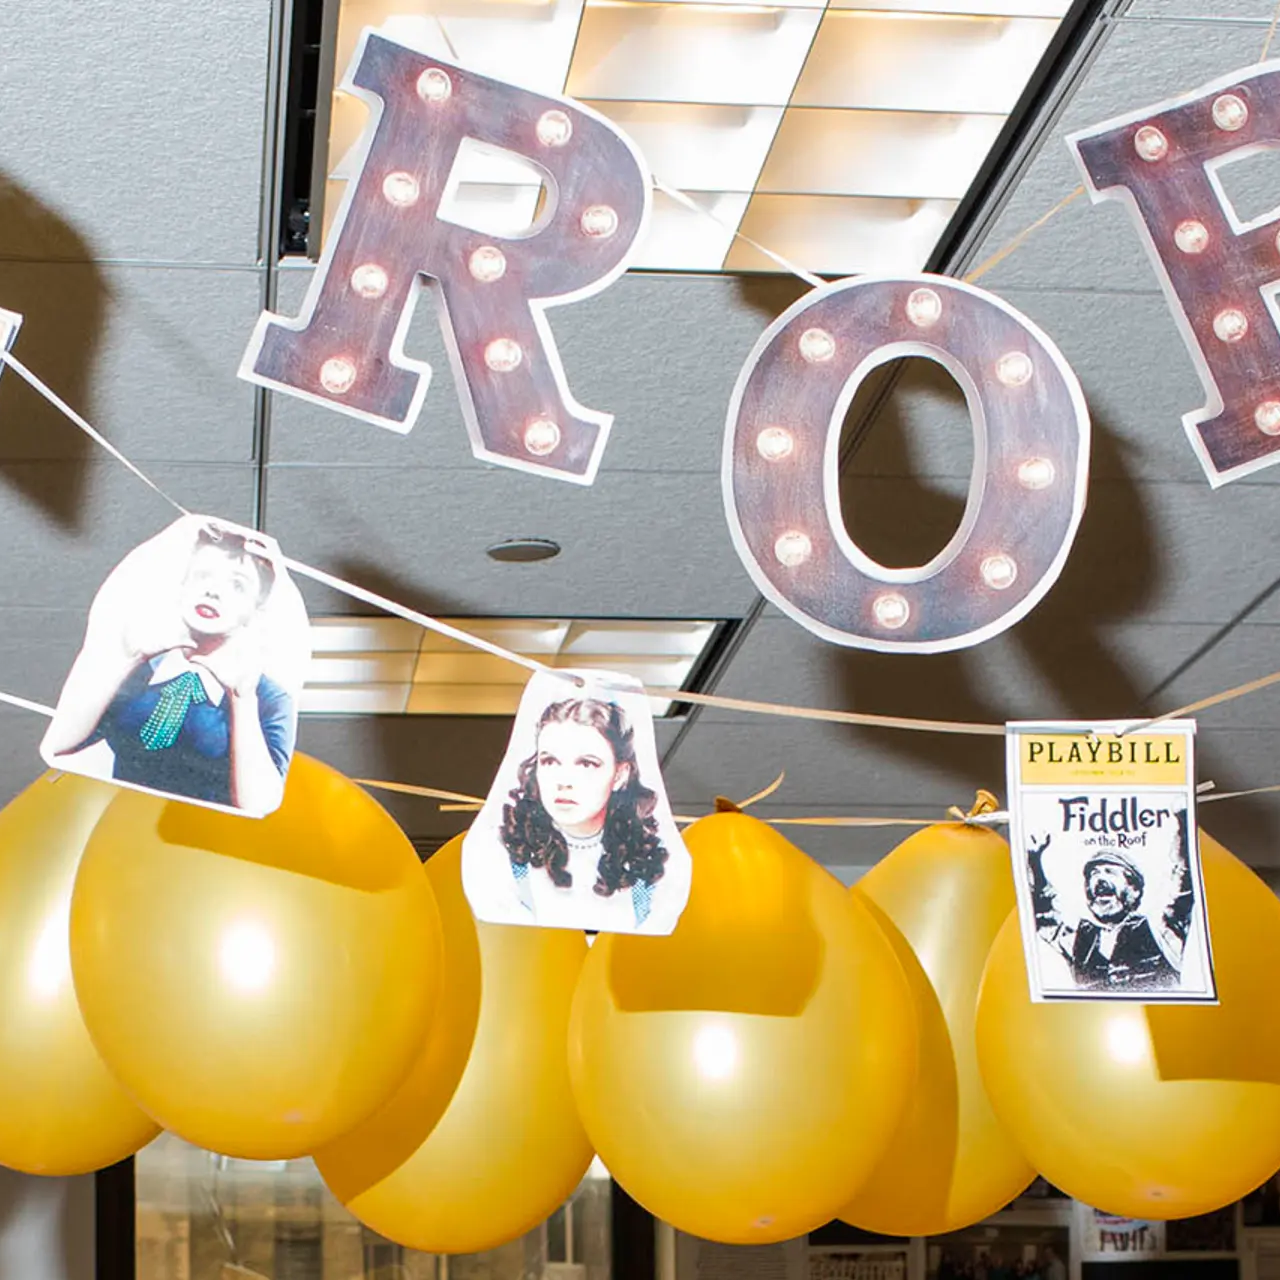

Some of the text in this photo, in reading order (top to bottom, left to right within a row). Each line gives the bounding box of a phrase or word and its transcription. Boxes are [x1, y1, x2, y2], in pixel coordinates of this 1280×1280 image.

[1028, 742, 1180, 763] PLAYBILL
[1058, 796, 1170, 833] Fiddler
[1098, 835, 1116, 847] the
[1118, 832, 1147, 849] Roof
